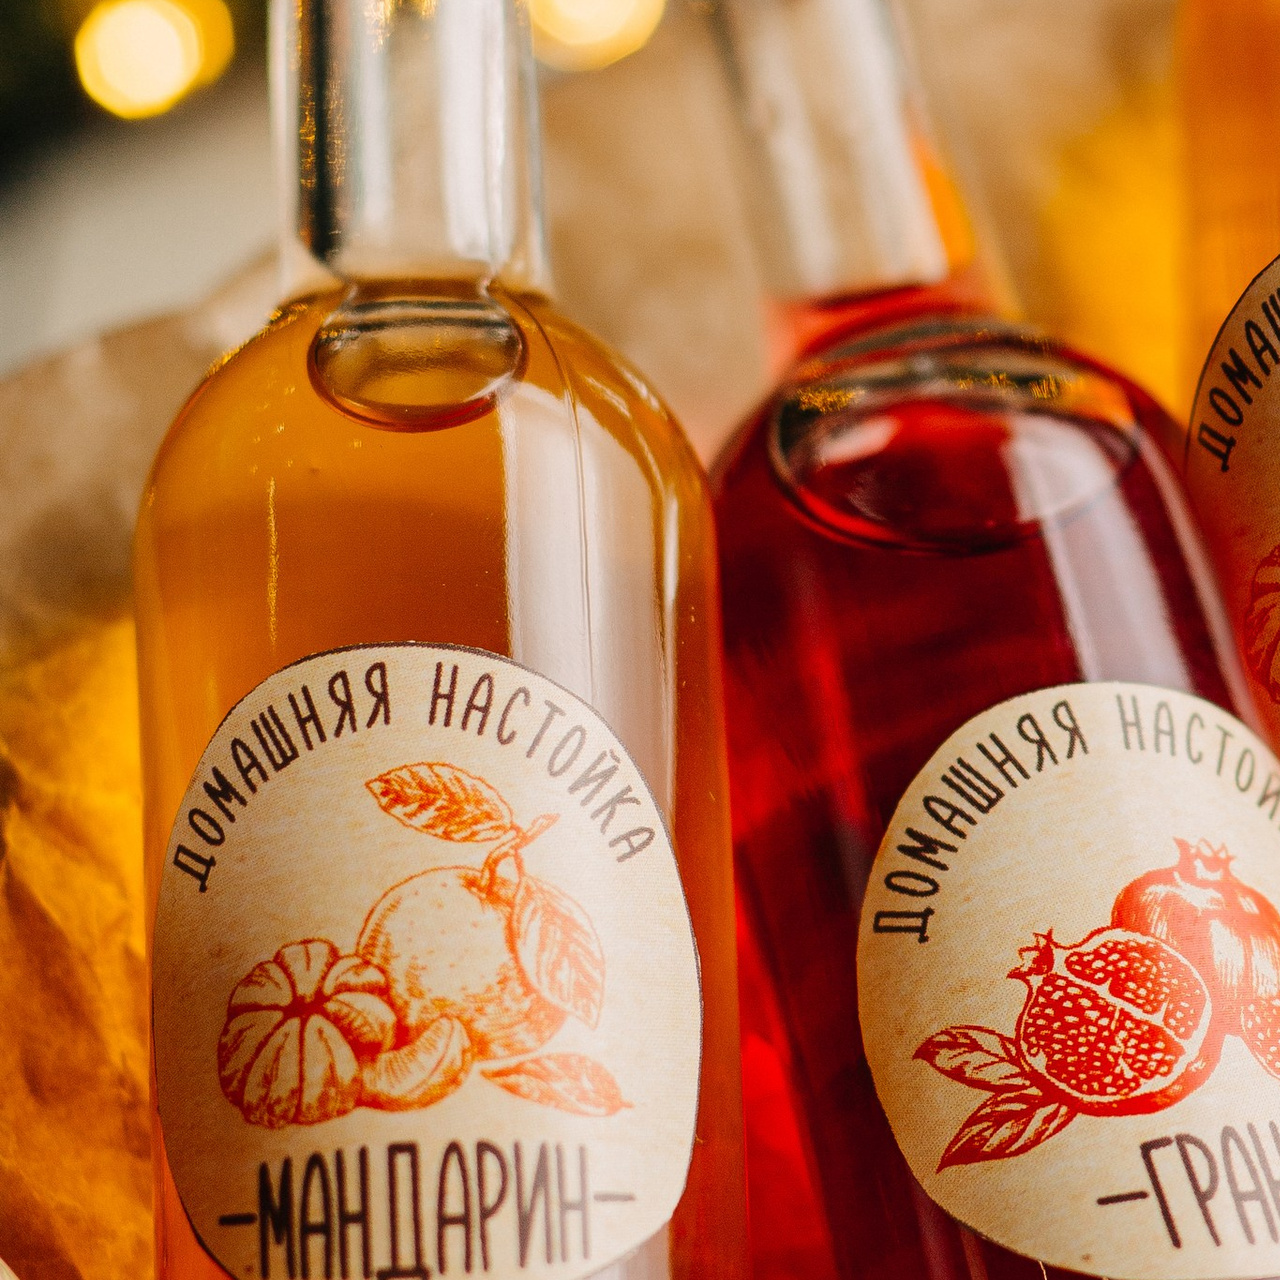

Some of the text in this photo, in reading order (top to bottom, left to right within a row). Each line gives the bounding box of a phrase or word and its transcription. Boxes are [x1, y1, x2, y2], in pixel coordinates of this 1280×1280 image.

[173, 660, 657, 894] ДОМАШНЯЯ НАСТОЙКА
[872, 699, 1090, 944] ДОМАШНЯЯ
